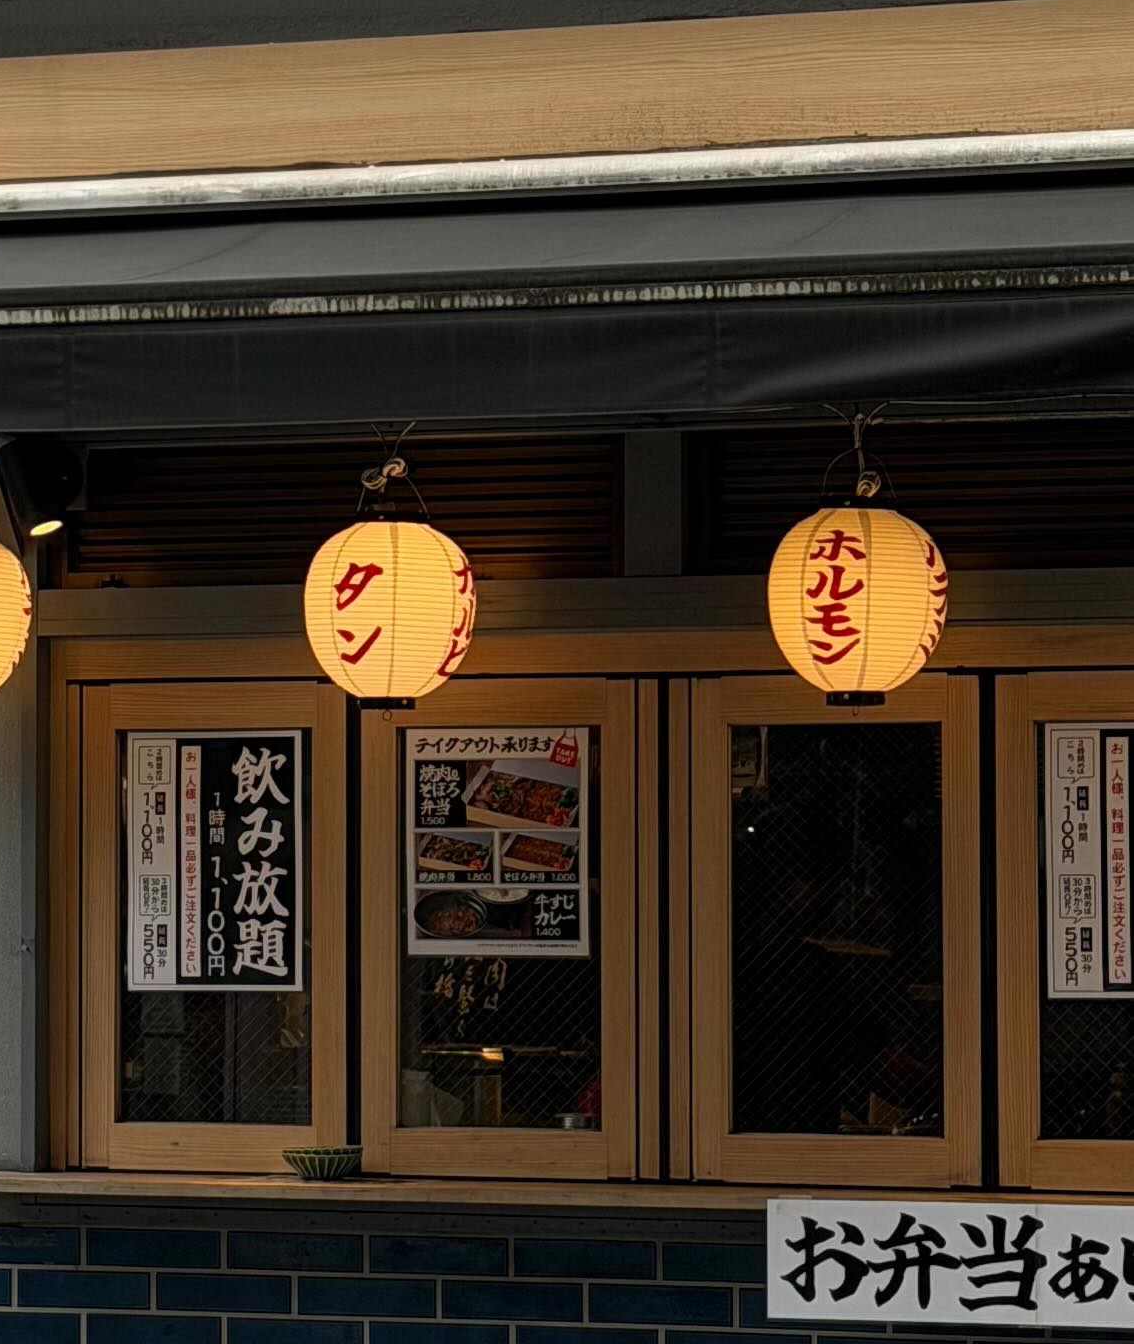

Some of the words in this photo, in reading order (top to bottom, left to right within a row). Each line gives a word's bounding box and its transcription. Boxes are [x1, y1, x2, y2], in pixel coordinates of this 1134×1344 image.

[333, 562, 384, 665] タン
[803, 529, 867, 666] ホルモン
[415, 736, 555, 754] テイクアウト承ります
[208, 791, 227, 846] 1時間
[418, 798, 452, 816] 弁当
[231, 745, 291, 977] 飲み放題
[534, 911, 577, 927] カレー
[142, 924, 155, 980] 550円
[1065, 926, 1079, 987] 550円
